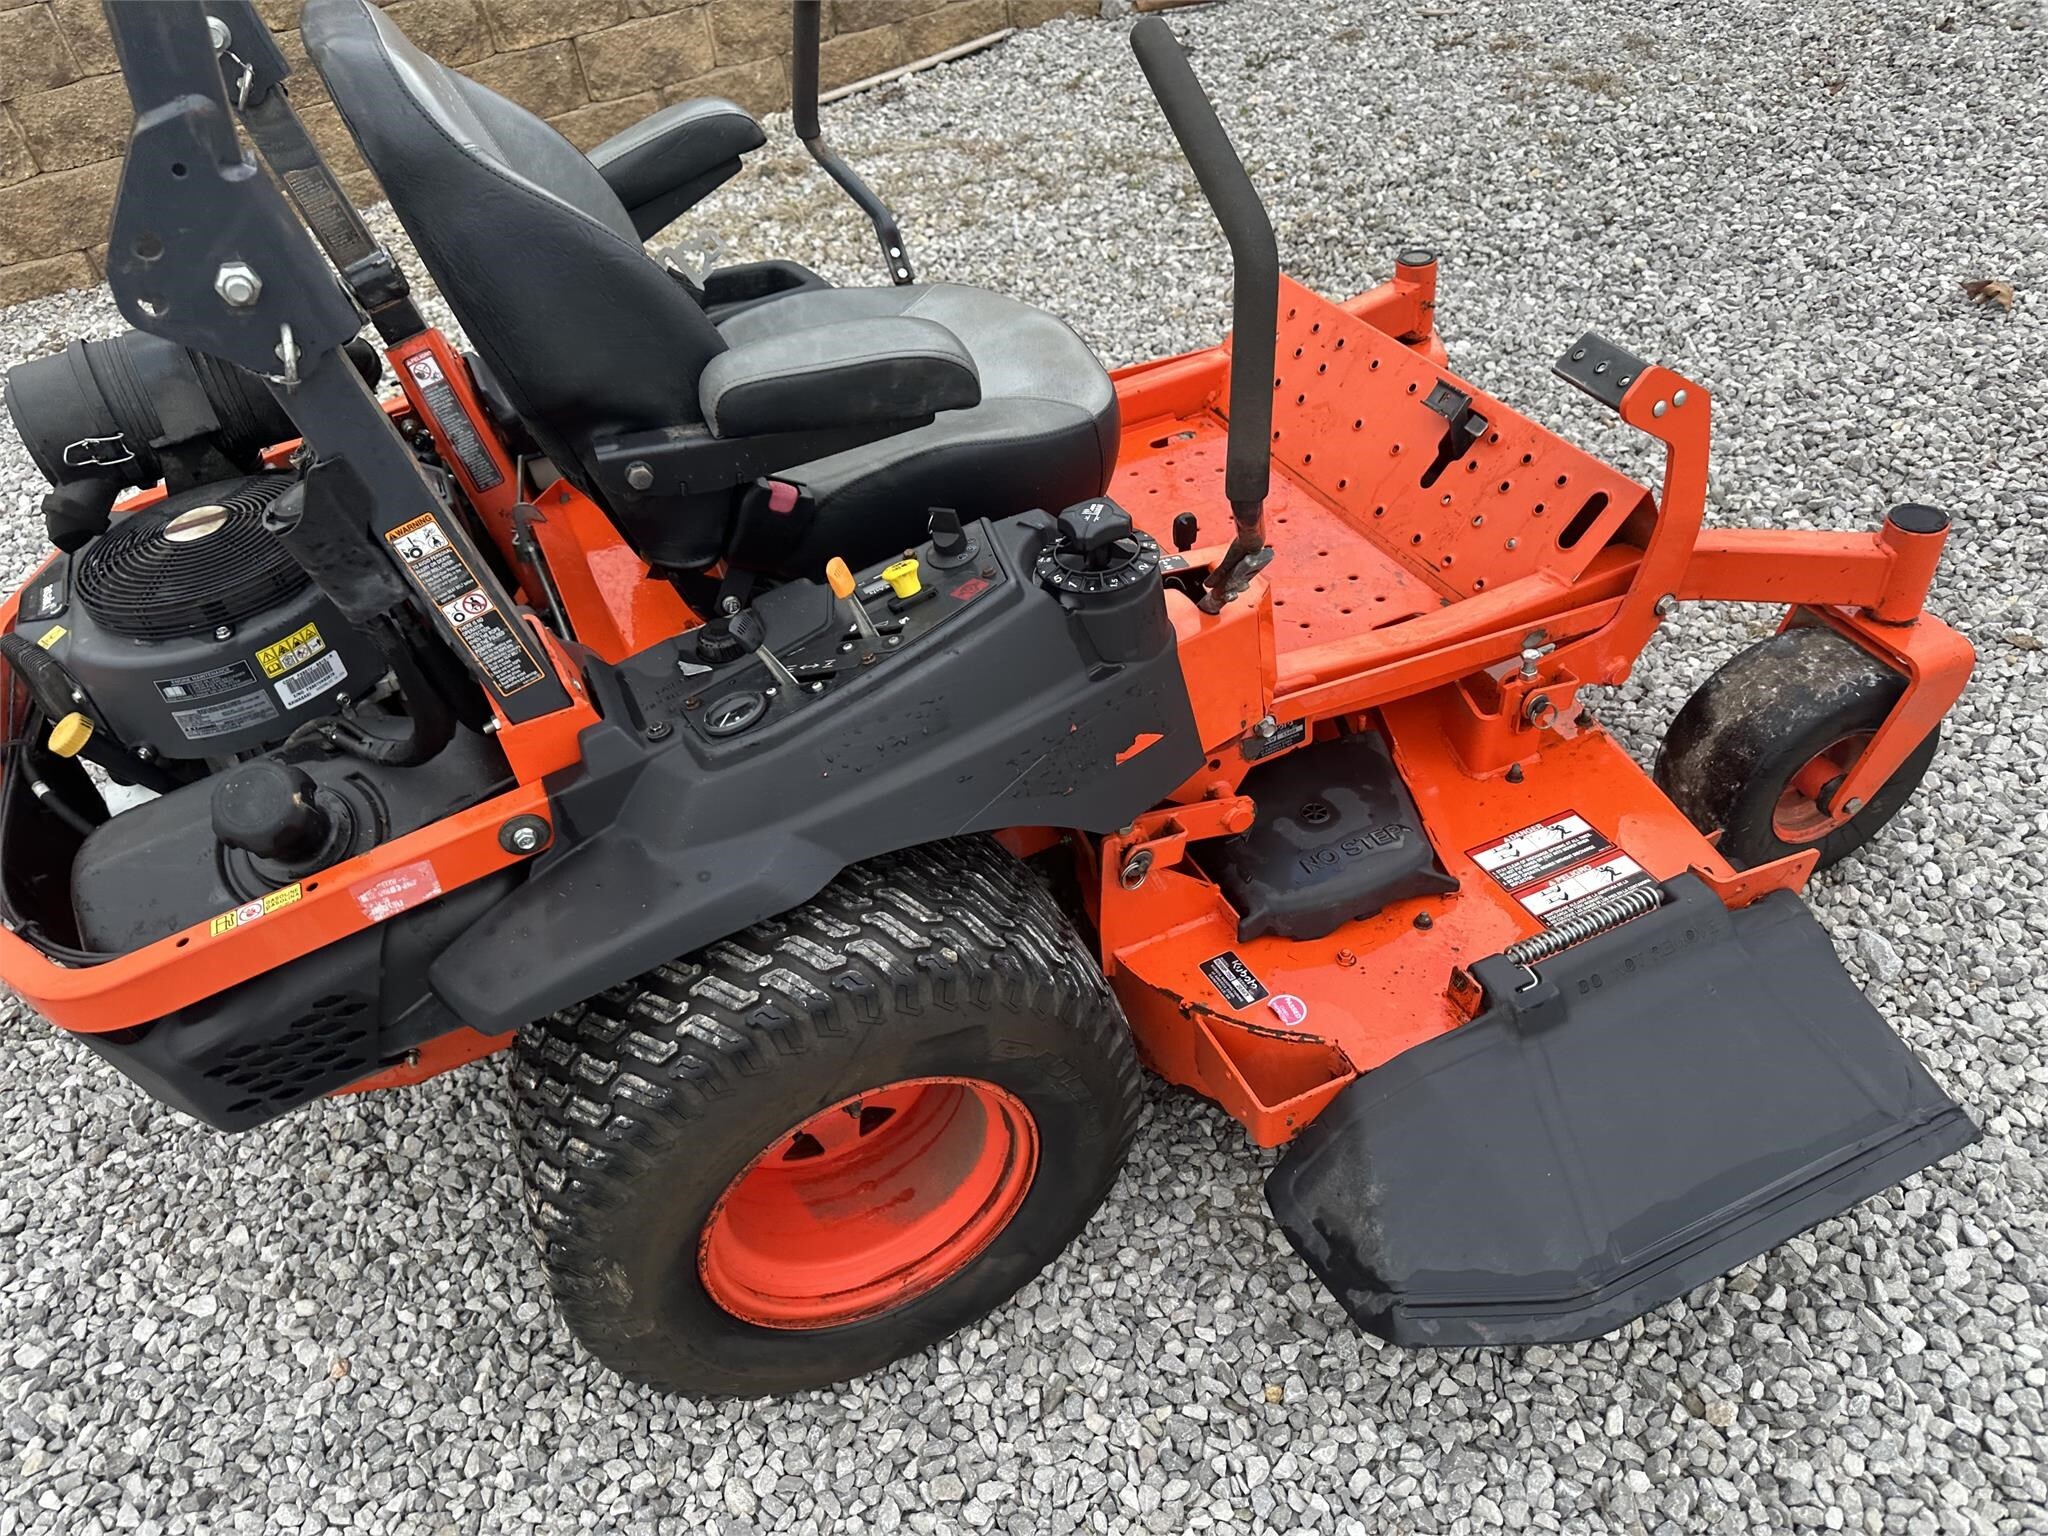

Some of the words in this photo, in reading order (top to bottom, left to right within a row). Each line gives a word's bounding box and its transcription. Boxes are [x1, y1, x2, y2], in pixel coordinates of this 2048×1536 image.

[394, 514, 432, 536] WARNING
[1138, 563, 1149, 571] 2
[1511, 823, 1544, 838] DANGER
[1299, 848, 1340, 874] NO
[1341, 824, 1403, 856] STEP
[1554, 864, 1592, 882] PELIGRO
[1232, 960, 1258, 989] Kubota
